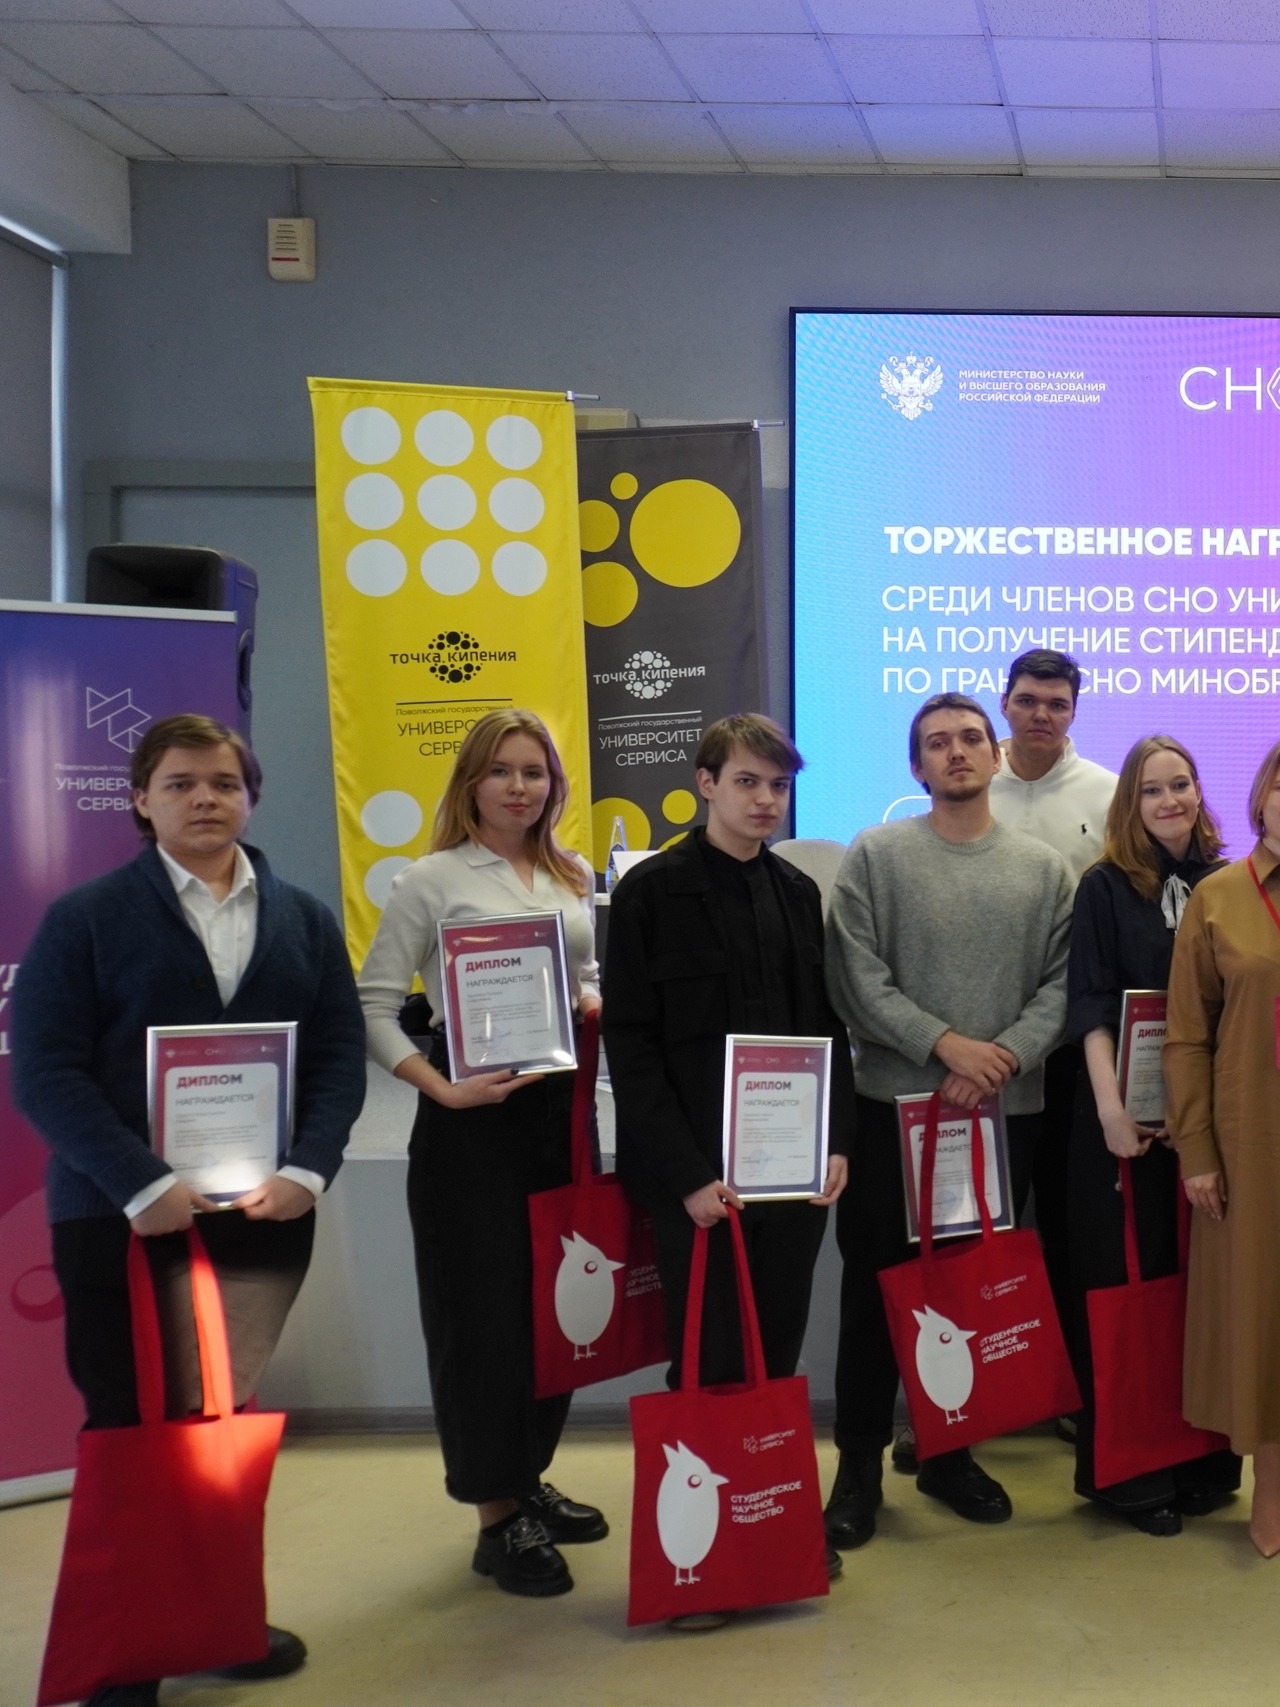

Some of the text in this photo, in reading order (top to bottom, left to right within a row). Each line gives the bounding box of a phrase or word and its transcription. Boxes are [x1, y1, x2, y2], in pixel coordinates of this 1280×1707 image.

[958, 370, 1084, 380] МИНИСТЕРСТВО НАУКИ
[958, 381, 1106, 392] И ВЫСШЕГО ОБРАЗОВАНИЯ
[958, 391, 1101, 403] РОССИЙСКОЙ ФЕДЕРАЦИИ
[883, 526, 1193, 556] ТОРЖЕСТВЕННОЕ
[881, 585, 991, 616] СРЕДИ
[1001, 586, 1135, 612] ЧЛЕНОВ
[1143, 586, 1219, 613] СНО
[882, 627, 927, 652] НА
[937, 627, 1131, 653] ПОЛУЧЕНИЕ
[389, 651, 517, 664] точка кипения
[593, 666, 706, 684] точка кипения
[882, 667, 932, 694] ПО
[396, 707, 446, 716] Поволжский
[598, 716, 703, 731] Поволжский государственный
[599, 728, 703, 750] УНИВЕРСИТЕТ
[615, 749, 687, 766] СЕРВИСА
[465, 957, 522, 973] ДИПЛОМ
[176, 1073, 243, 1090] ДИПЛОМ
[745, 1080, 792, 1092] ДИПЛОМ
[979, 1319, 1041, 1347] СТУДЕНЧЕСКОЕ
[981, 1336, 1019, 1355] НАУЧНОЕ
[982, 1342, 1029, 1364] ОБЩЕСТВО
[730, 1480, 803, 1504] СТУДЕНЧЕСКОЕ
[731, 1498, 775, 1513] НАУЧНОЕ
[732, 1506, 785, 1524] ОБЩЕСТВО
